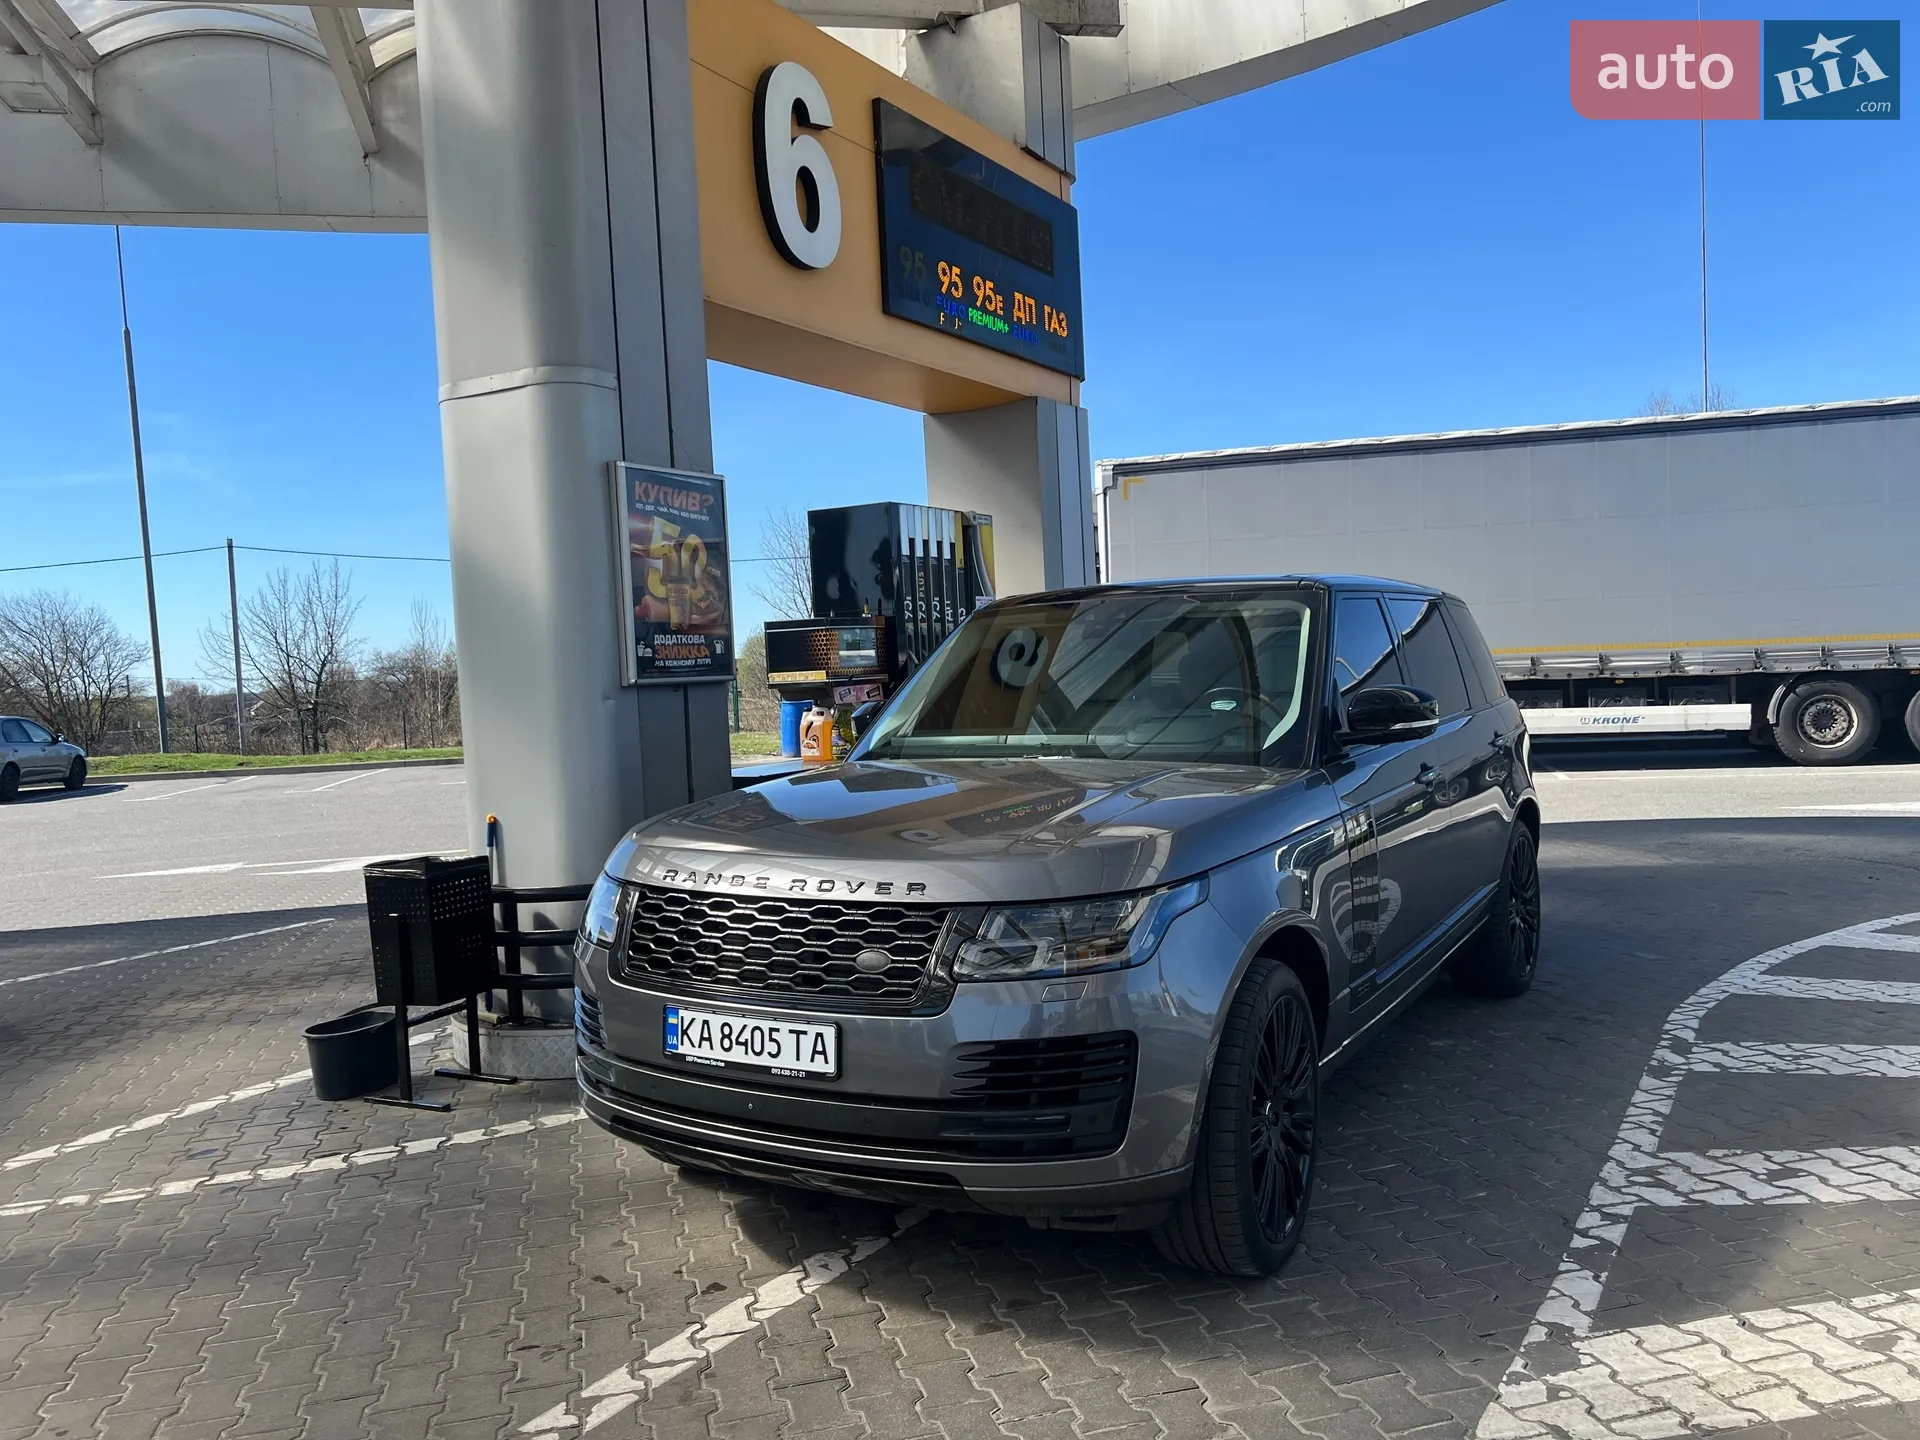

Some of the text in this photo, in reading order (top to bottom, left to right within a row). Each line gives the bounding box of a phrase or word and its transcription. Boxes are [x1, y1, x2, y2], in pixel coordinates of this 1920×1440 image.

[754, 62, 842, 269] 6
[937, 261, 963, 298] 95
[968, 307, 1010, 334] PREMIUM+
[1013, 291, 1068, 338] ДП ГАЗ
[635, 480, 713, 513] КУПИВ?
[654, 634, 706, 646] ДОДАТКОВА
[655, 645, 710, 659] ЗНИЖКА
[1592, 716, 1640, 725] KRONE
[661, 868, 928, 896] RANGE ROVER
[667, 1034, 678, 1046] UA
[680, 1016, 829, 1064] KA 8405 TA
